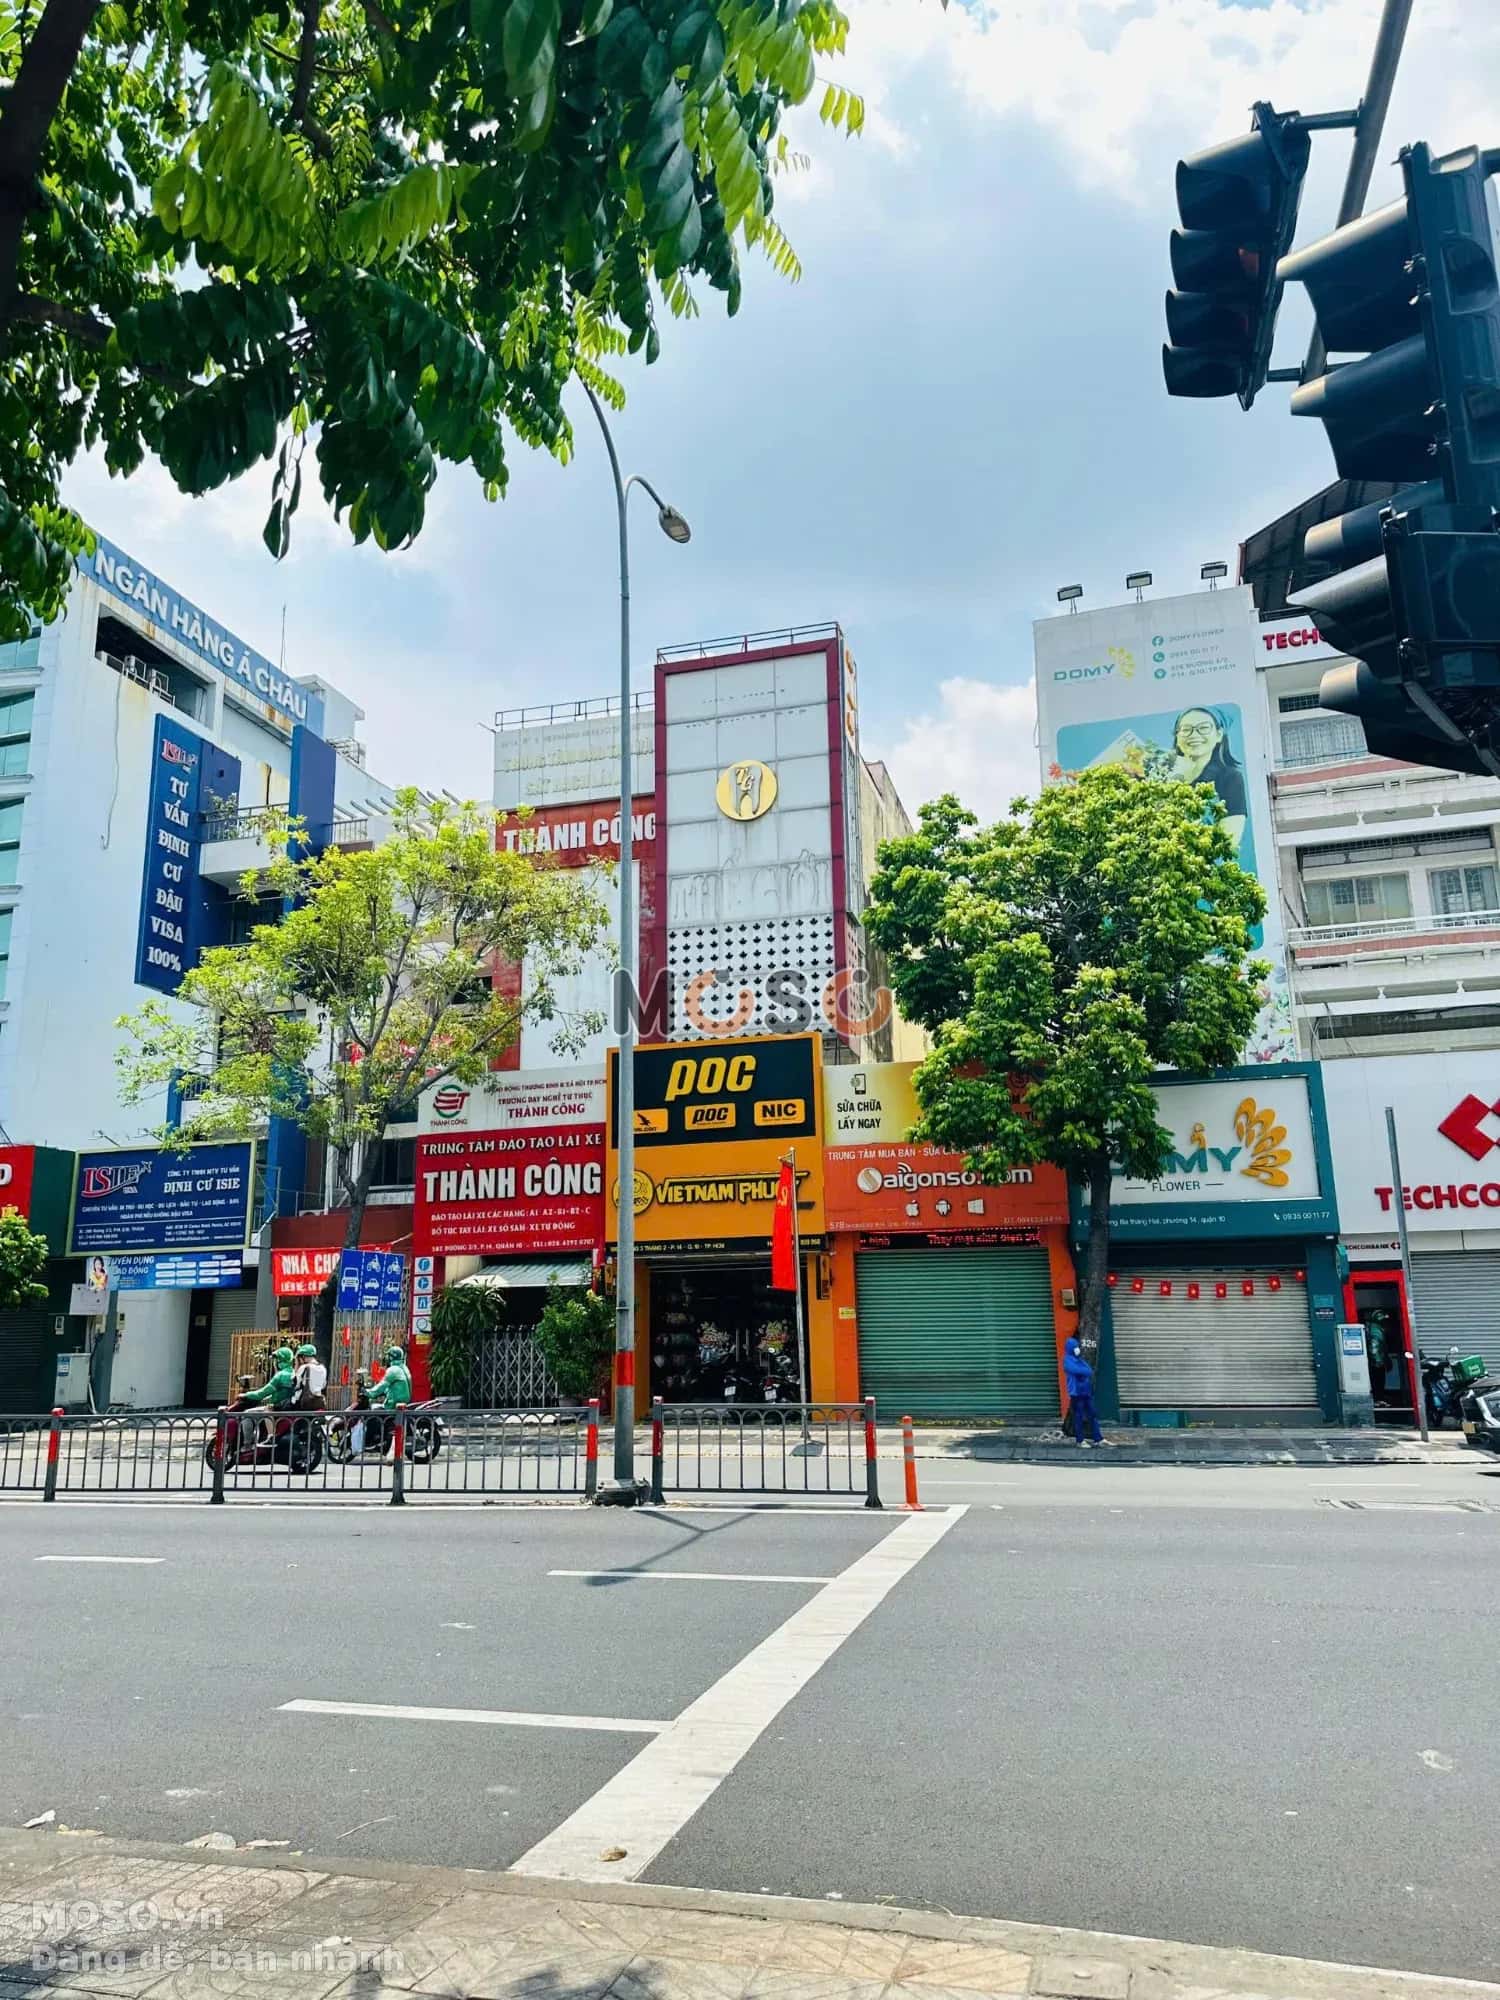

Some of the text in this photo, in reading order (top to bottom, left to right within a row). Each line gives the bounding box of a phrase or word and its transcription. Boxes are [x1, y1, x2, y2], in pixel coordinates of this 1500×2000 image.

[95, 548, 307, 719] NGÂN HÀNG Á CHÂU
[1262, 628, 1325, 651] TECH
[1053, 663, 1116, 681] DOMY
[169, 776, 189, 799] TƯ
[163, 799, 189, 828] VẤN
[158, 829, 190, 858] ĐỊNH
[162, 862, 183, 883] CƯ
[155, 887, 184, 913] ĐẬU
[150, 915, 184, 944] VISA
[146, 946, 182, 973] 100%
[508, 1101, 586, 1119] THÀNH CÔNG
[762, 1103, 797, 1118] NIC
[837, 1098, 882, 1113] SỬA CHỮA
[838, 1114, 882, 1130] LẤY NGAY
[422, 1142, 465, 1156] TRUNG
[468, 1138, 495, 1153] TÂM
[498, 1136, 526, 1151] ĐÀO
[529, 1136, 555, 1151] TẠO
[584, 1133, 602, 1145] XE
[828, 1151, 856, 1161] TRUNG
[859, 1149, 876, 1160] TÂM
[878, 1149, 897, 1159] MUA
[163, 1177, 241, 1196] ĐỊNH CƯ ISIE
[422, 1156, 602, 1203] THÀNH CÔNG
[656, 1175, 735, 1205] VIETNAM
[1152, 1181, 1201, 1192] FLOWER
[282, 1251, 311, 1277] NHÀ
